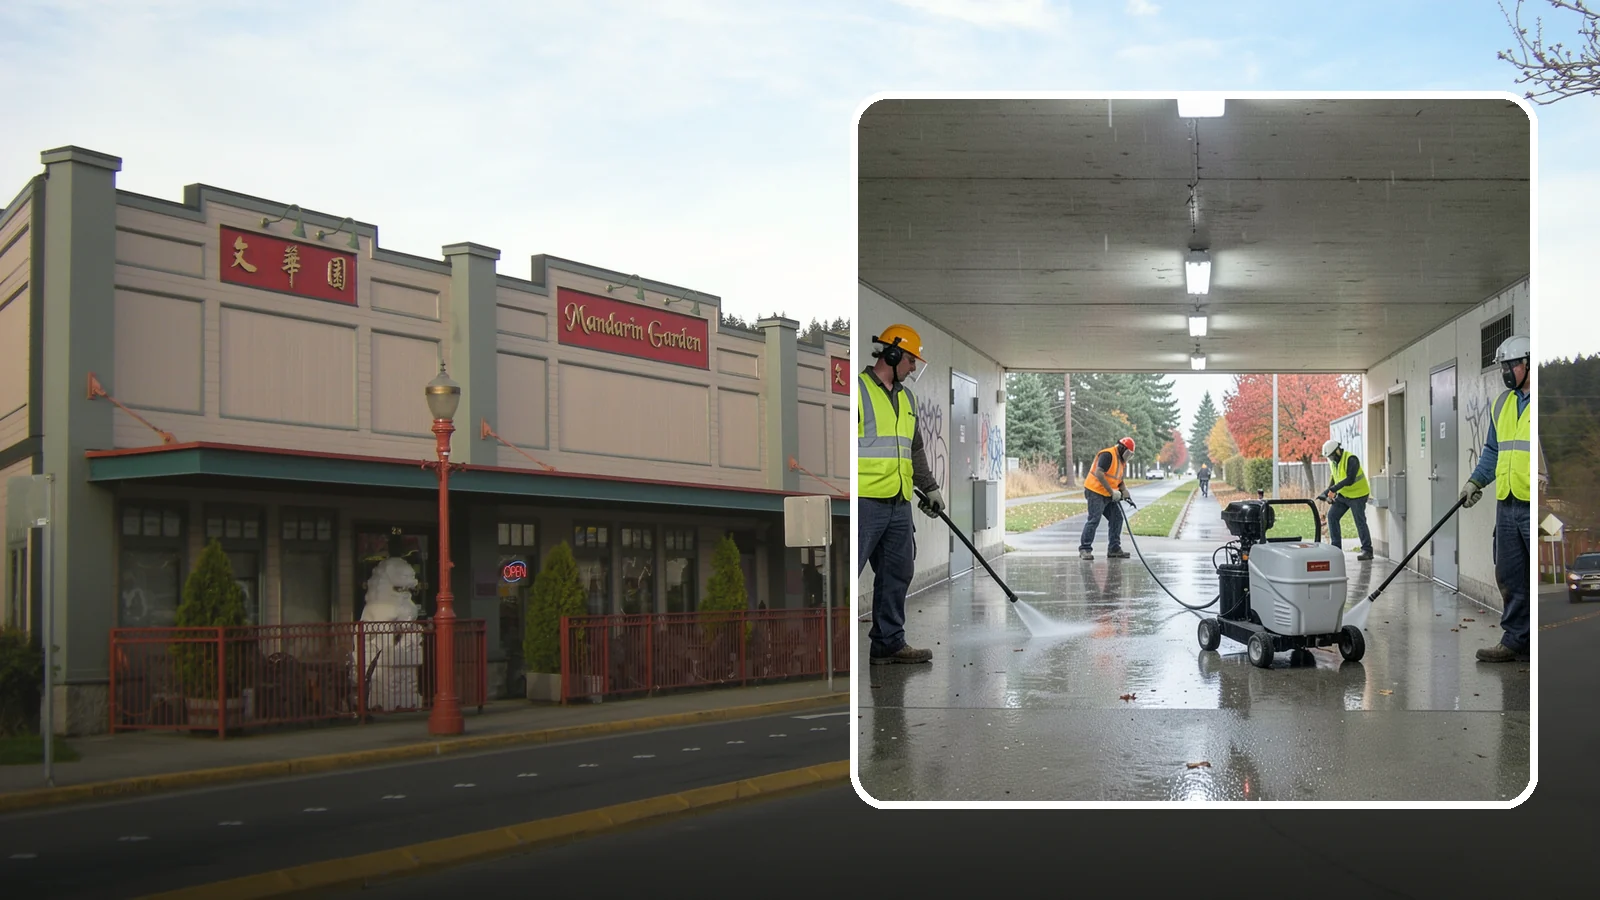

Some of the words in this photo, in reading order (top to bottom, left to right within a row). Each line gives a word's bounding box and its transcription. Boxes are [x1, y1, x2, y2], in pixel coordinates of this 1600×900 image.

[231, 236, 346, 291] 文華園
[564, 302, 643, 341] Mandarin
[648, 320, 701, 352] Garden
[503, 565, 527, 578] OPEN
